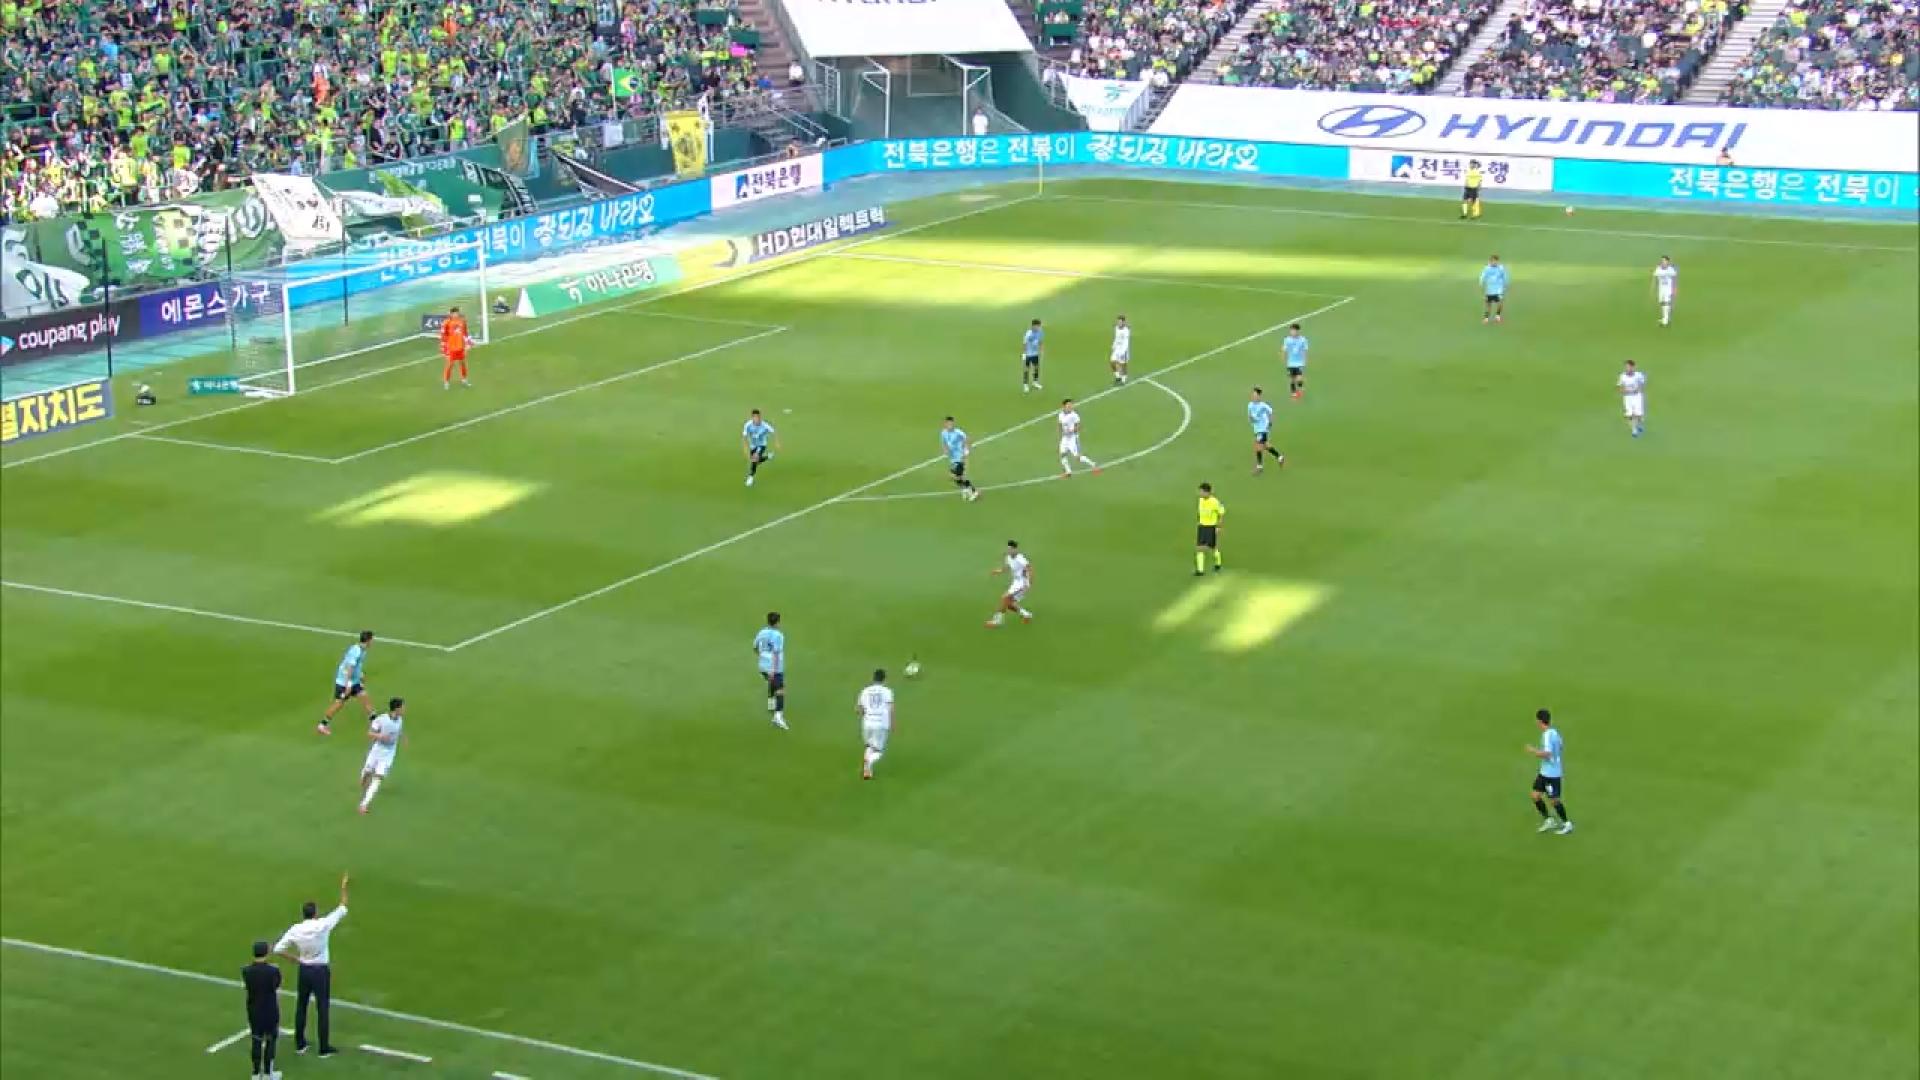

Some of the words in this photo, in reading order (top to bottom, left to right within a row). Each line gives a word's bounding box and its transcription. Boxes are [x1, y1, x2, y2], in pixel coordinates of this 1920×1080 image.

[1439, 113, 1747, 151] HYUNDAI
[884, 137, 999, 169] 전북은행은
[1008, 134, 1075, 162] 전북이
[1178, 139, 1259, 171] 바라오
[1417, 158, 1509, 184] 전북행
[751, 162, 802, 194] 전북은행
[1669, 167, 1805, 199] 전북은행은
[1815, 173, 1899, 204] 전북이
[600, 193, 656, 232] 바라오
[757, 205, 886, 257] HD현대일렉트릭
[18, 320, 88, 350] coupang
